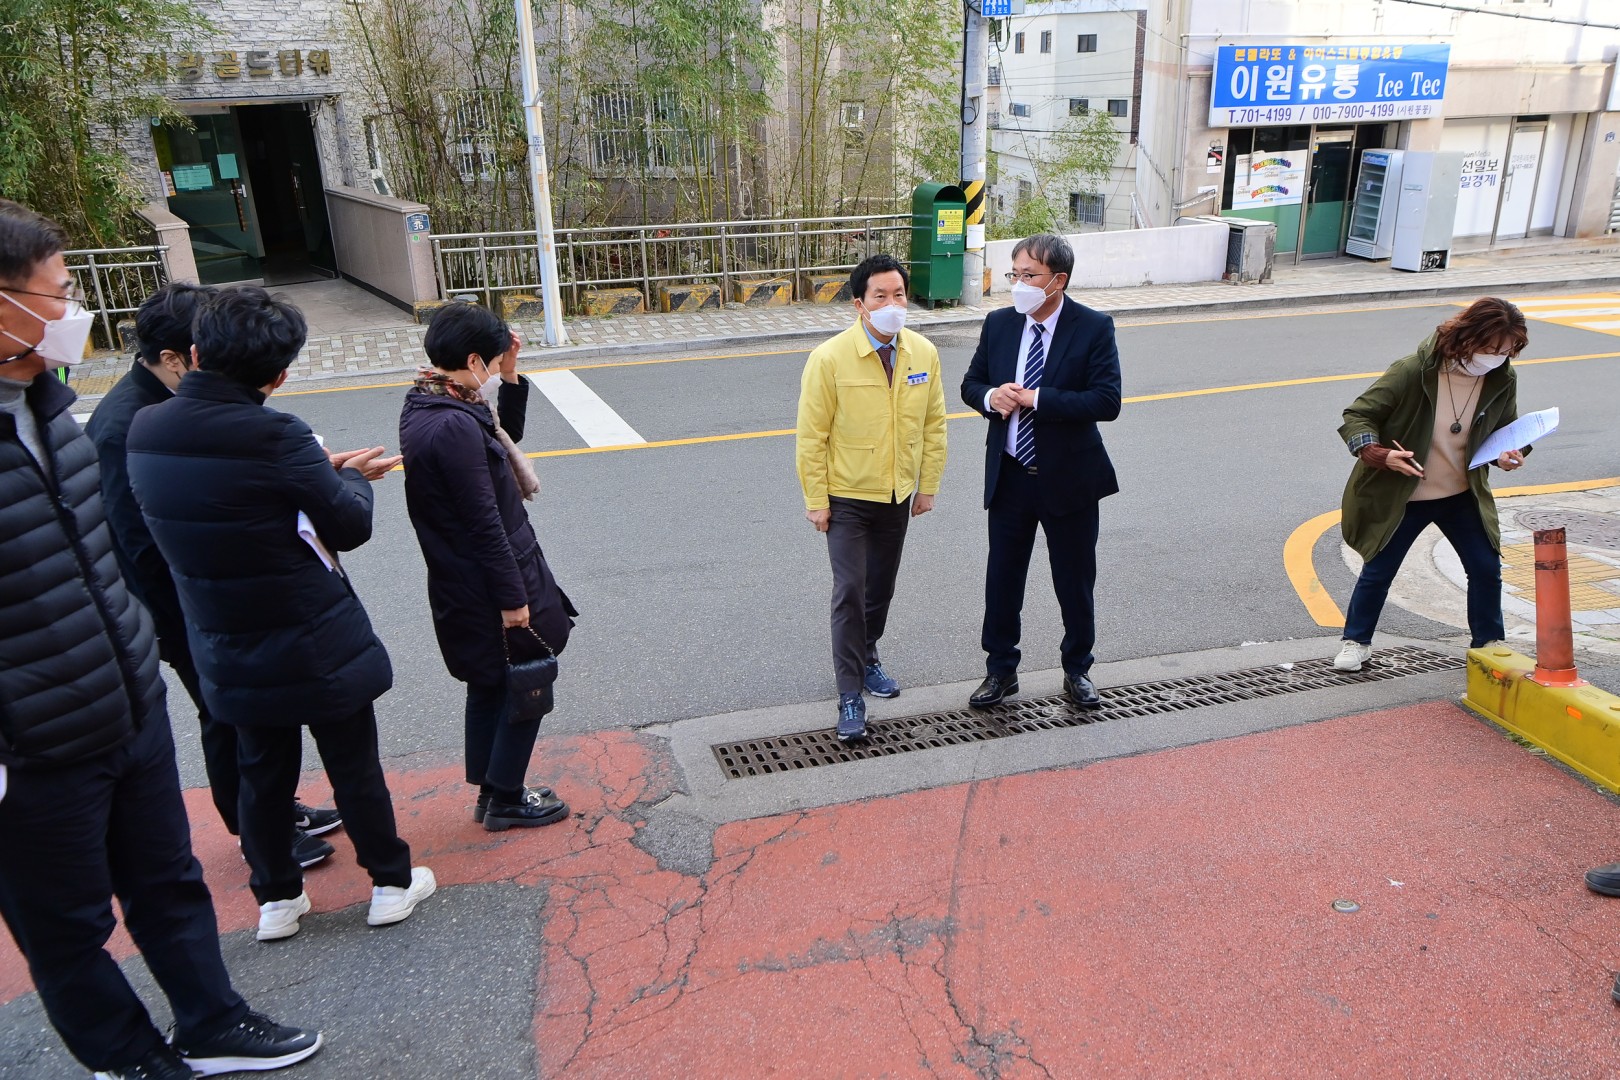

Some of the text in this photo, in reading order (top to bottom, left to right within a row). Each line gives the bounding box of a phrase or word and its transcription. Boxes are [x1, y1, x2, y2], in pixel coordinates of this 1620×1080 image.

[1230, 64, 1360, 101] 이원유통
[1376, 71, 1441, 98] Ice Tec
[1228, 107, 1292, 124] T.701-4199
[1312, 103, 1394, 120] 010-7900-4199
[413, 221, 424, 230] 36
